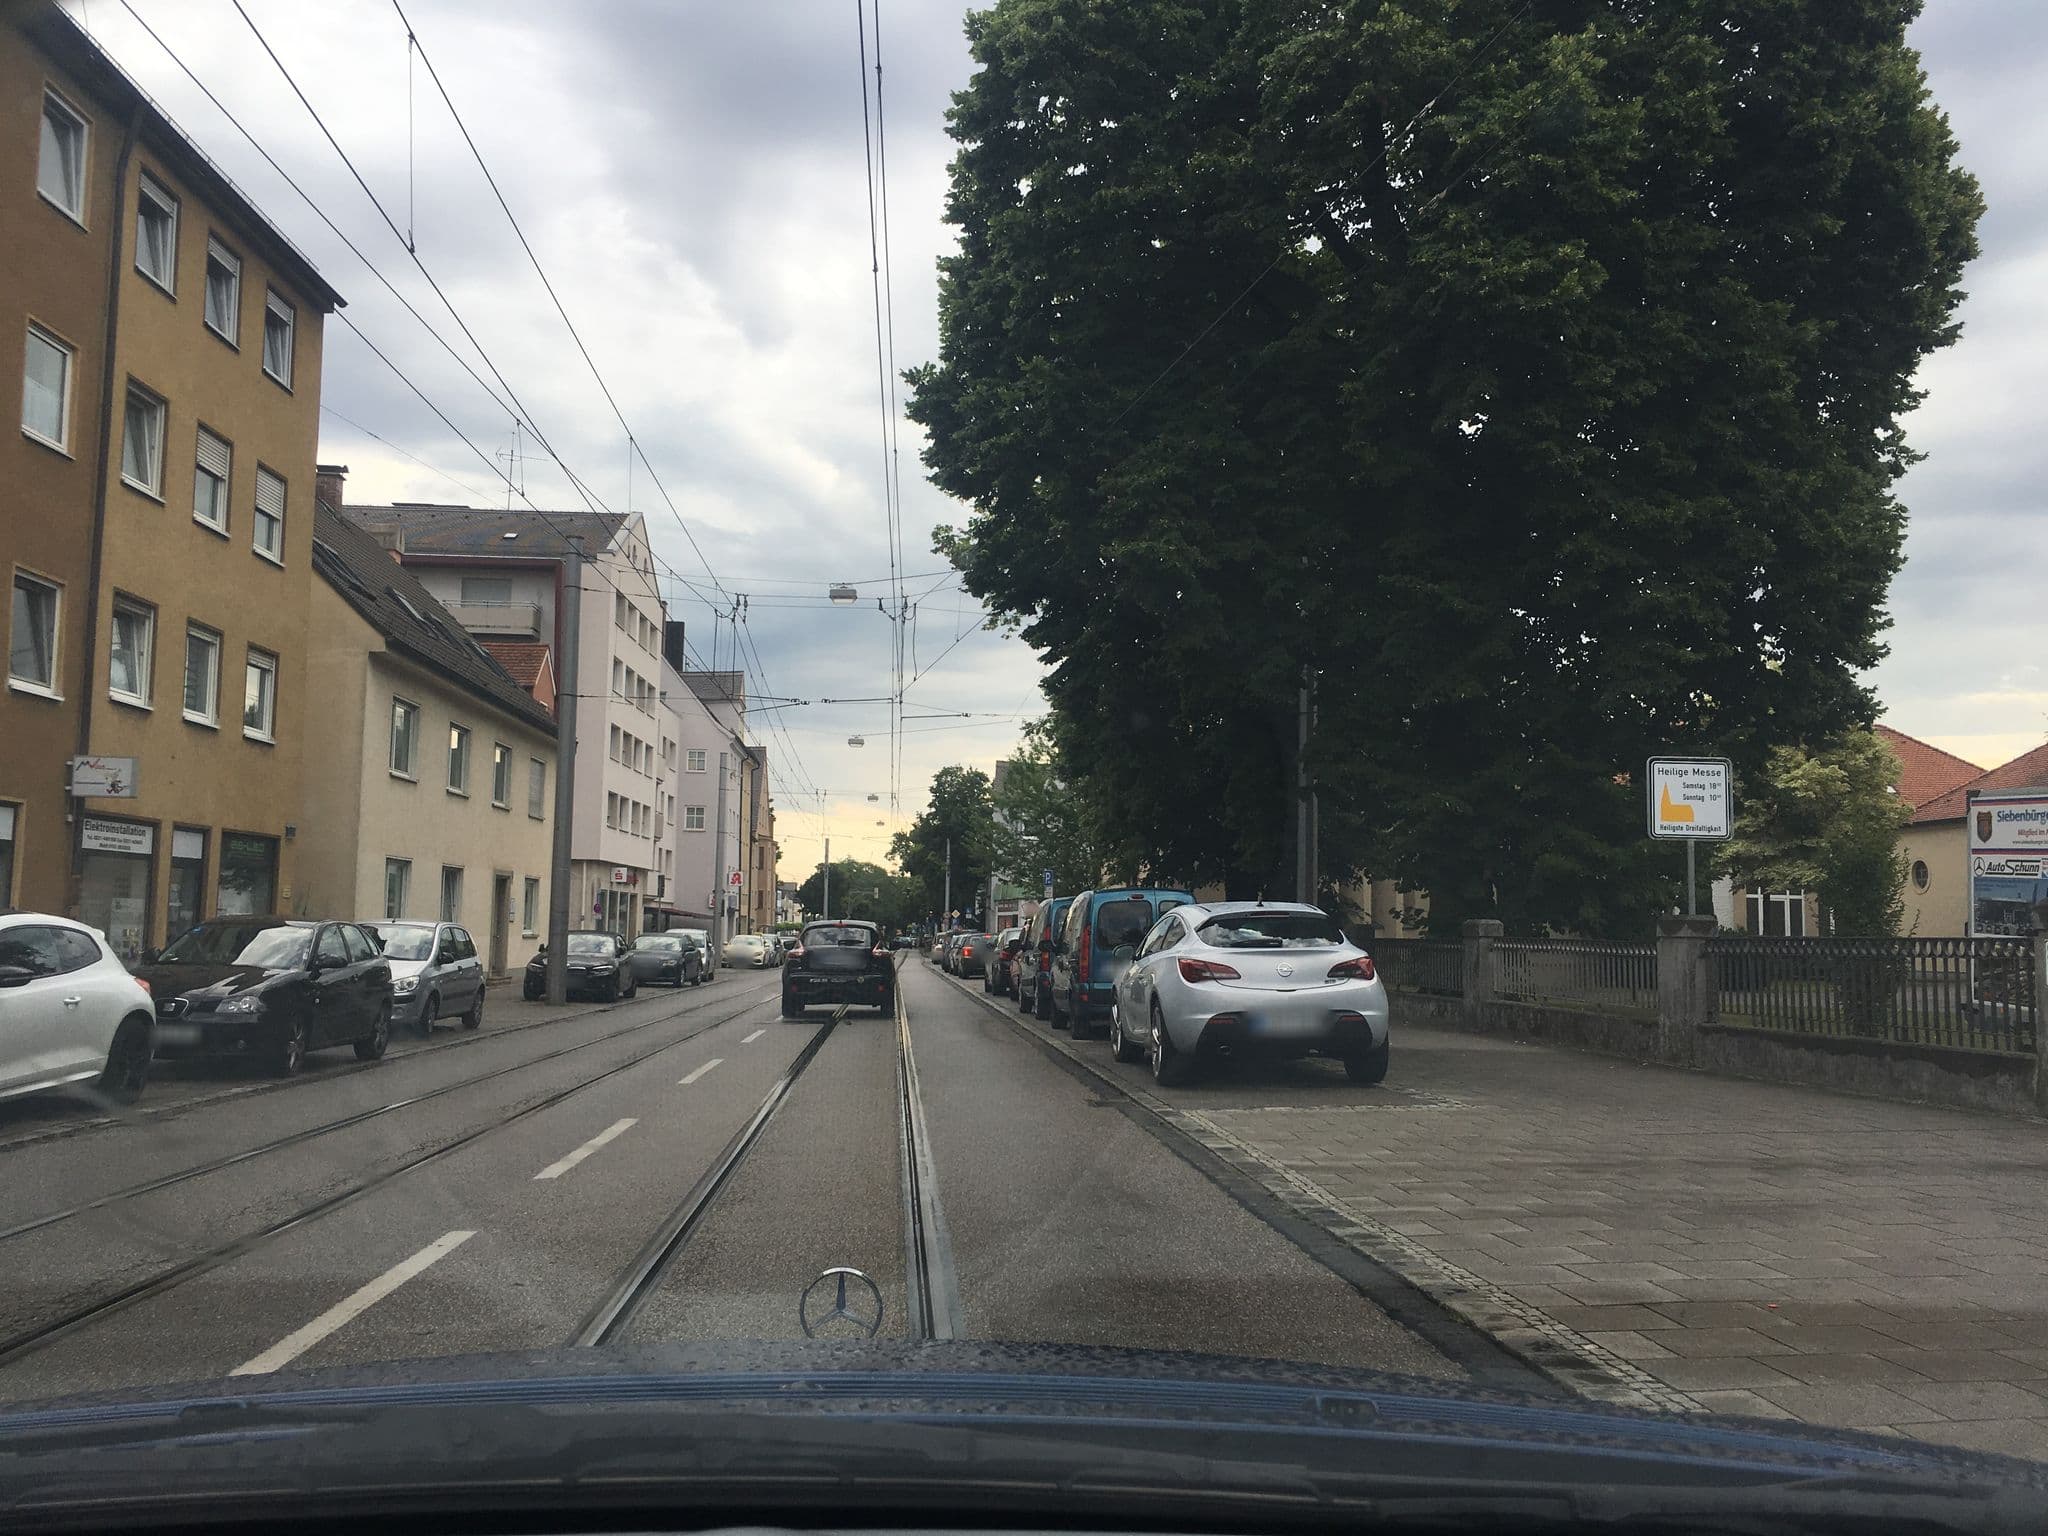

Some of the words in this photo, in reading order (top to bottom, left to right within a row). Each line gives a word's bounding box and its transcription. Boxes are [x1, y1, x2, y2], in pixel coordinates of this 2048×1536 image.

[1657, 767, 1689, 777] Heilige
[1692, 768, 1721, 777] Messe
[1682, 782, 1706, 790] Samstag
[1682, 793, 1705, 802] Sonntag
[85, 820, 146, 837] Elektroinstallation
[1660, 824, 1684, 832] Heiligste
[1685, 825, 1721, 833] Dreifaltigkeit
[1986, 861, 2006, 872] Auto
[1045, 872, 1052, 884] P
